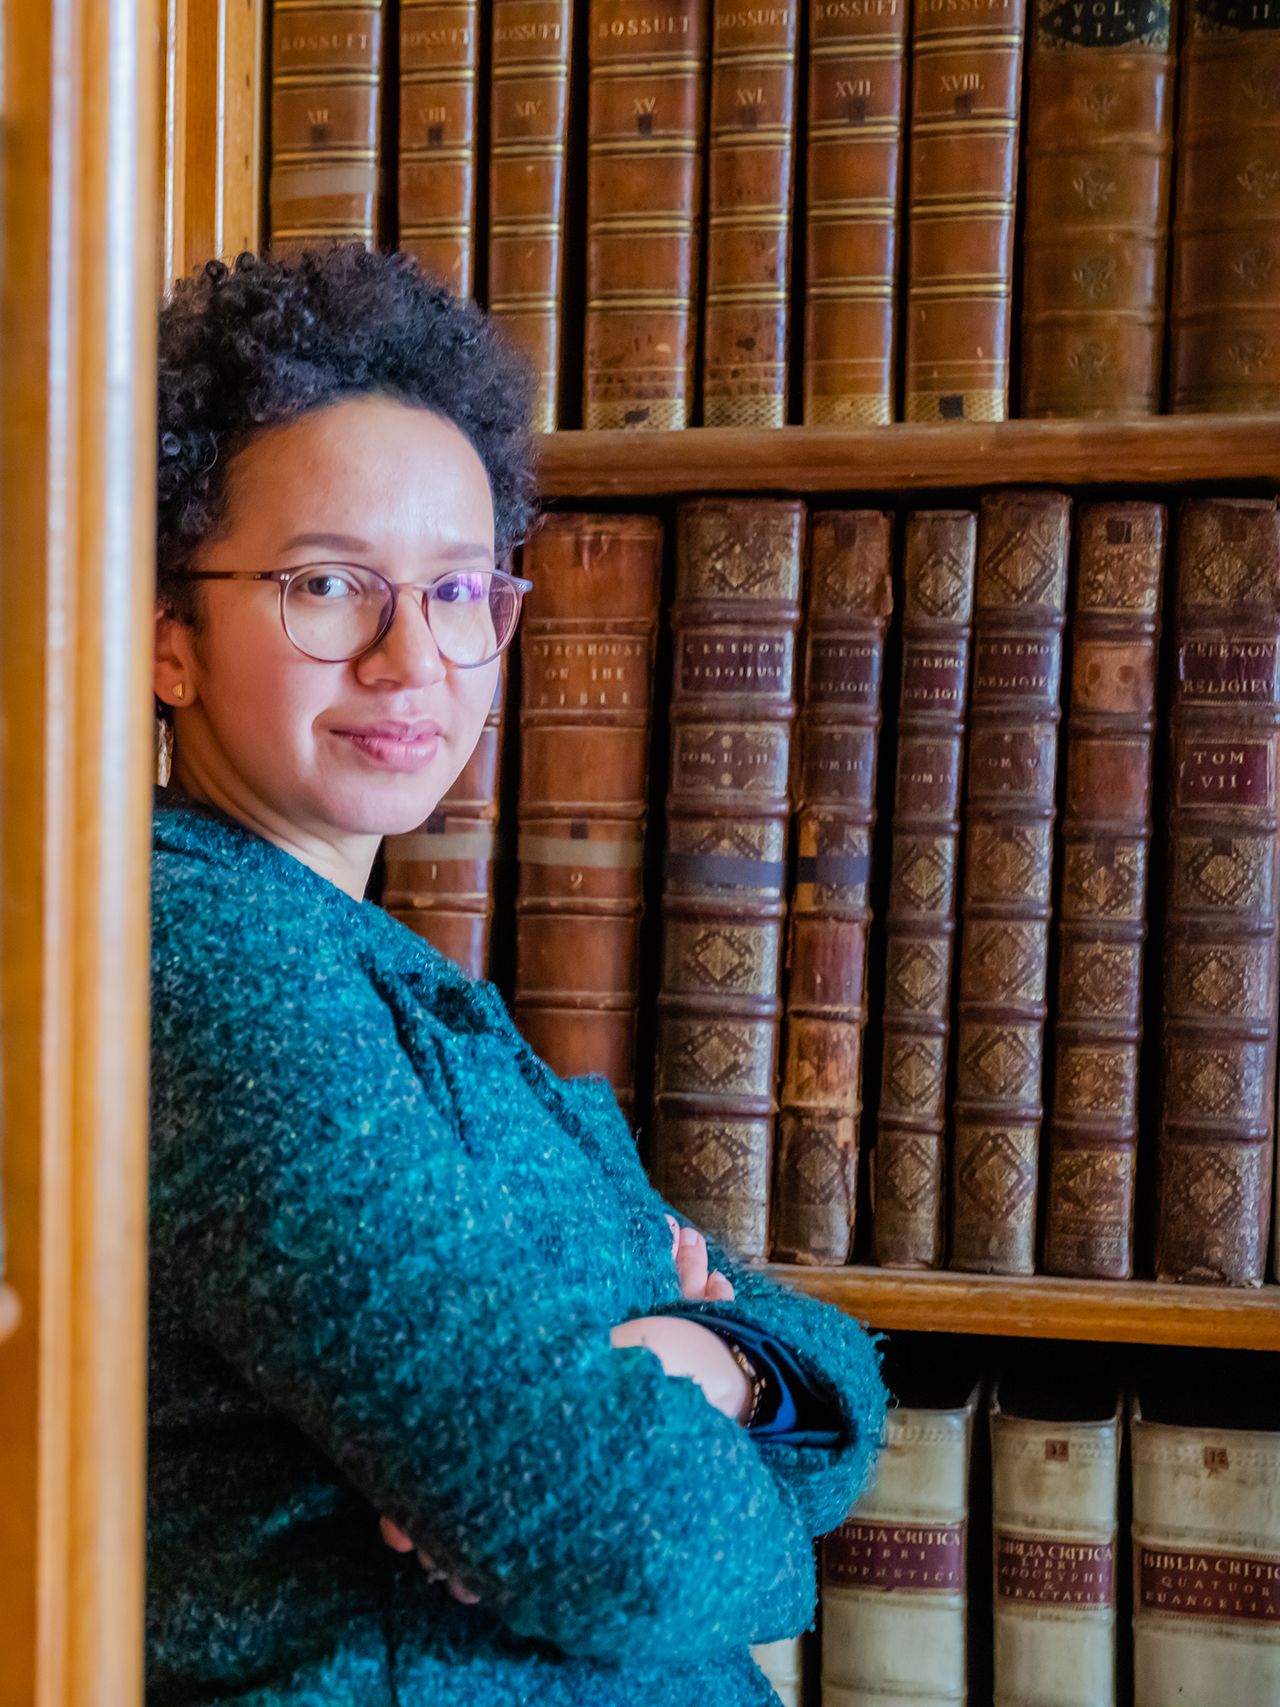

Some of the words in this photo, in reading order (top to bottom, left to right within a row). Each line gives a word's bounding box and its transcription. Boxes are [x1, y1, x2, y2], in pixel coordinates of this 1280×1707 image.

[816, 0, 896, 19] BOSSUET
[1073, 0, 1135, 18] VOL.
[599, 16, 689, 38] BOSSUET
[280, 34, 369, 51] BOSSUET
[835, 80, 875, 97] XVII.
[940, 73, 984, 92] XVIII.
[736, 88, 766, 105] XVI.
[686, 642, 786, 655] CEREMON
[545, 667, 569, 680] ON
[591, 667, 625, 680] THE
[540, 690, 630, 705] BIBLE
[1192, 751, 1245, 765] TOM
[431, 863, 438, 880] 1
[570, 872, 584, 889] 2
[832, 1526, 888, 1543] IBLIA
[894, 1529, 961, 1546] CRITICA
[850, 1546, 926, 1560] LIBRI
[1048, 1545, 1112, 1561] CRITICA
[1022, 1556, 1076, 1569] LIBRI
[1143, 1553, 1209, 1571] BIBLIA
[1161, 1575, 1270, 1597] QUATUOR
